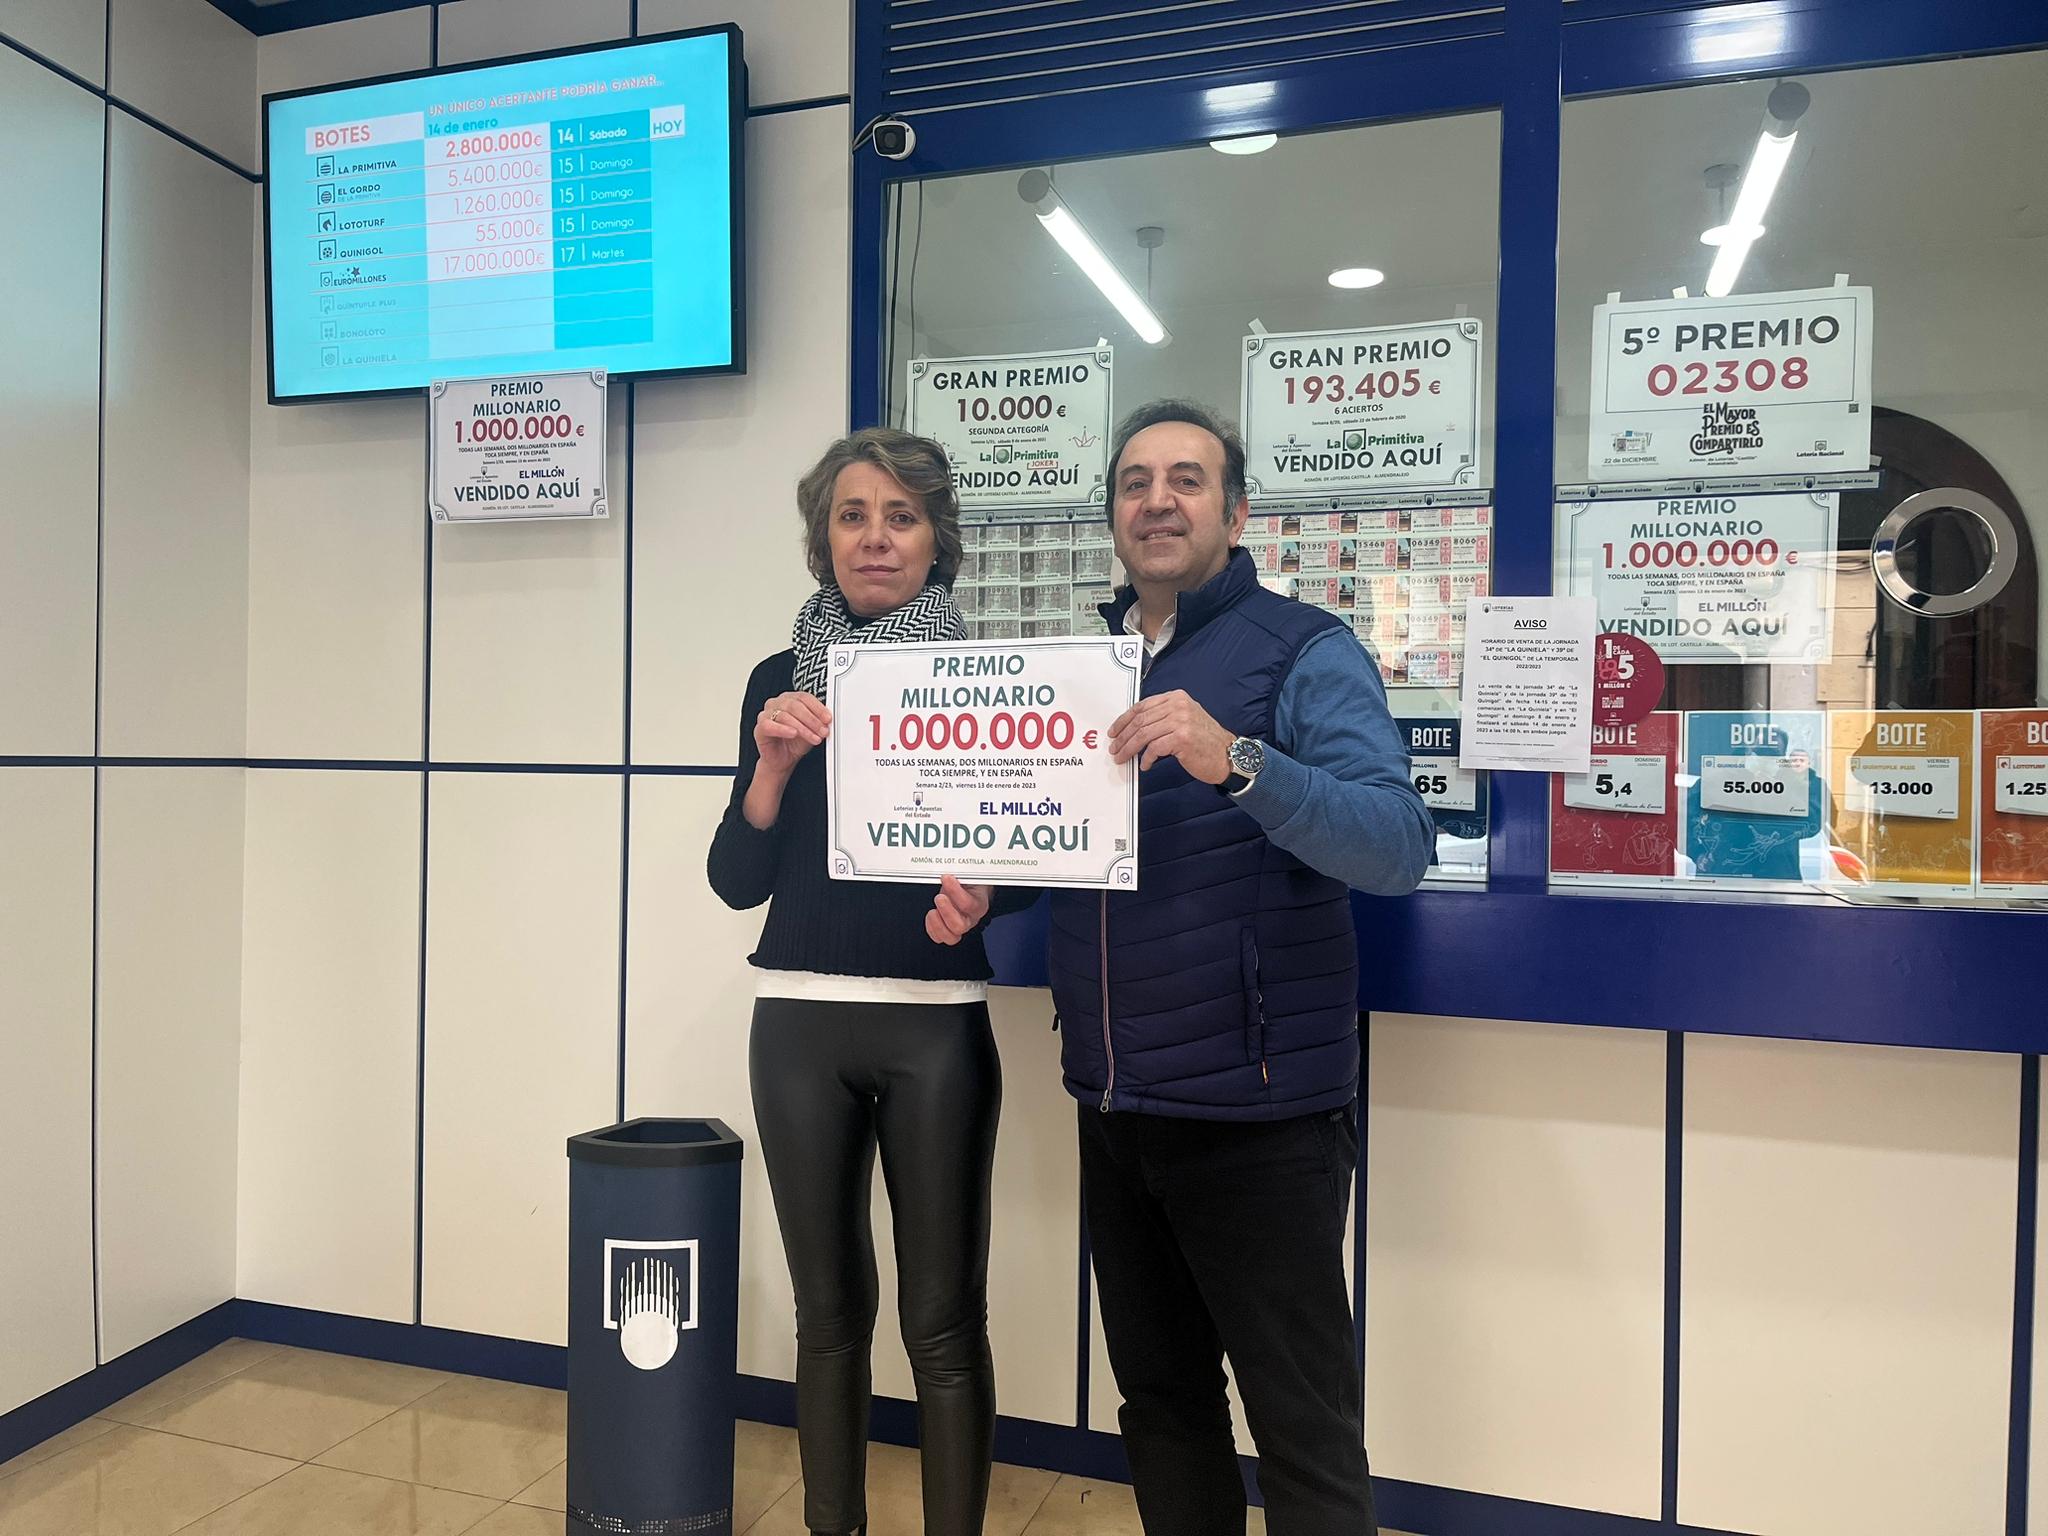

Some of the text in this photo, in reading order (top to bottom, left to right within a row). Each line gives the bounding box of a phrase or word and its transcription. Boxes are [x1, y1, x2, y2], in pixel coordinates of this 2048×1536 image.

[428, 105, 444, 117] UN
[448, 99, 485, 114] ÚNICO
[489, 89, 557, 108] ACERTANTE
[561, 79, 606, 98] PODRÍA
[428, 117, 498, 135] 14 de enero
[653, 119, 682, 135] HOY
[315, 125, 371, 148] BOTES
[445, 131, 542, 158] 2.800.000€
[557, 127, 627, 144] 14 Sábado
[338, 160, 397, 175] LA PRIMITIVA
[448, 160, 543, 187] 5.400.000€
[559, 157, 633, 174] 15 Domingo
[338, 184, 381, 196] EL GORDO
[560, 187, 634, 203] 15 Domingo
[454, 189, 544, 215] 1.260.000€
[339, 218, 385, 231] LOTOTURF
[476, 219, 545, 242] 55.000€
[560, 217, 634, 233] 15 Domingo
[340, 247, 383, 258] QUINIGOL
[444, 249, 545, 274] 17.000.000€
[561, 247, 625, 263] 17 Martes
[334, 275, 386, 287] EUROMILLONES
[340, 328, 386, 339] BONOLOTO
[1675, 315, 1840, 352] PREMIO
[355, 354, 397, 364] QUINIELA
[1269, 338, 1452, 369] GRAN PREMIO
[933, 364, 1089, 391] GRAN PREMIO
[1647, 356, 1809, 397] 02308
[491, 381, 544, 397] PREMIO
[1285, 368, 1441, 404] 193.405 €
[473, 399, 561, 417] MILLONARIO
[958, 394, 1066, 423] 10.000 €
[1334, 403, 1384, 415] 6 ACIERTOS
[1703, 403, 1715, 414] EL
[455, 414, 585, 443] 1.000.000 €
[968, 423, 1049, 436] SEGUNDA CATEGORÍA
[1327, 432, 1425, 450] La Primitiva
[980, 449, 1058, 462] La Primitiva
[1273, 443, 1442, 473] VENDIDO AQUÍ
[519, 470, 530, 479] EL
[950, 464, 1079, 489] ENDIDO AQUÍ
[454, 478, 580, 502] VENDIDO AQUÍ
[1657, 499, 1737, 516] PREMIO
[1630, 520, 1763, 538] MILLONARIO
[1300, 542, 1328, 551] 01953
[1358, 541, 1385, 549] 15468
[1412, 539, 1440, 548] 06349
[1602, 538, 1798, 569] 1.000.000 €
[1300, 579, 1327, 588] 01953
[1699, 602, 1714, 612] EL
[1514, 619, 1547, 629] AVISO
[1600, 612, 1788, 636] VENDIDO AQUÍ
[1603, 639, 1612, 658] 1
[933, 655, 1025, 678] PREMIO
[1618, 655, 1635, 680] 5
[901, 684, 1055, 709] MILLONARIO
[869, 711, 1098, 751] 1.000.000 €
[1412, 727, 1452, 746] BOTE
[1730, 723, 1778, 745] BOTE
[1877, 723, 1927, 745] BOTE
[875, 757, 1083, 768] TODAS LAS SEMANAS, DOS MILLONARIOS EN ESPAÑA
[919, 767, 1033, 778] TOCA SIEMPRE, Y EN ESPAÑA
[1415, 775, 1447, 794] 65
[1595, 774, 1632, 797] 5,4
[1723, 781, 1784, 794] 55.000
[1870, 782, 1933, 795] 13.000
[980, 802, 998, 815] EL
[867, 818, 1090, 852] VENDIDO AQUÍ
